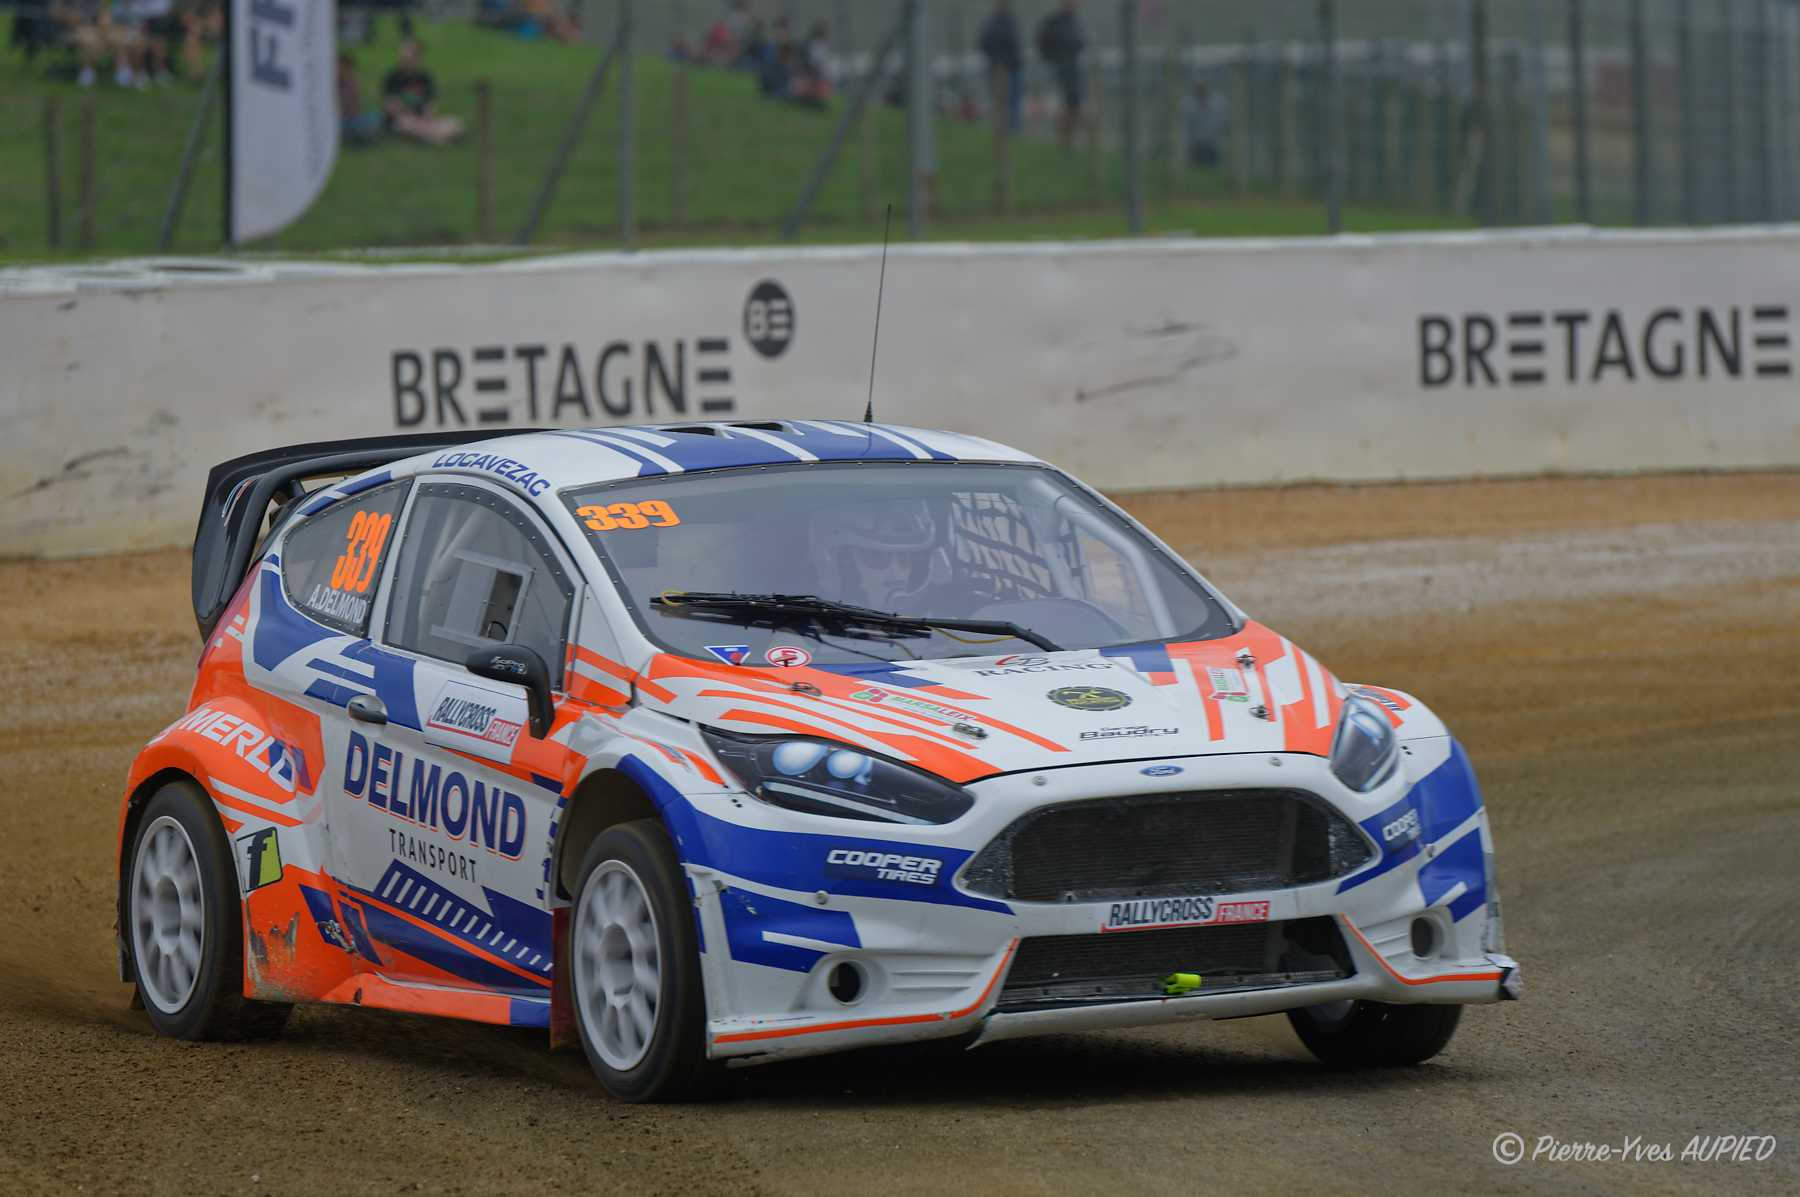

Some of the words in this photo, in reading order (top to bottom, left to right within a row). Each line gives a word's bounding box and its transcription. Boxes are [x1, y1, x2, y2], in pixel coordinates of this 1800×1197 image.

[1419, 306, 1792, 388] BRETAGNE
[392, 337, 734, 429] BRETAGNE
[432, 453, 550, 497] LOCAVEZAC
[575, 499, 681, 531] 339
[331, 511, 392, 593] 339
[974, 663, 1112, 676] RACING
[432, 697, 496, 733] RALLYCROSS
[178, 708, 297, 793] MERLO
[343, 730, 527, 861] DELMOND
[389, 828, 476, 883] TRANSPORT
[827, 849, 942, 874] COOPER
[876, 868, 937, 885] TIRES
[1109, 897, 1214, 927] RALLYCROSS
[1219, 903, 1267, 921] FRANCE
